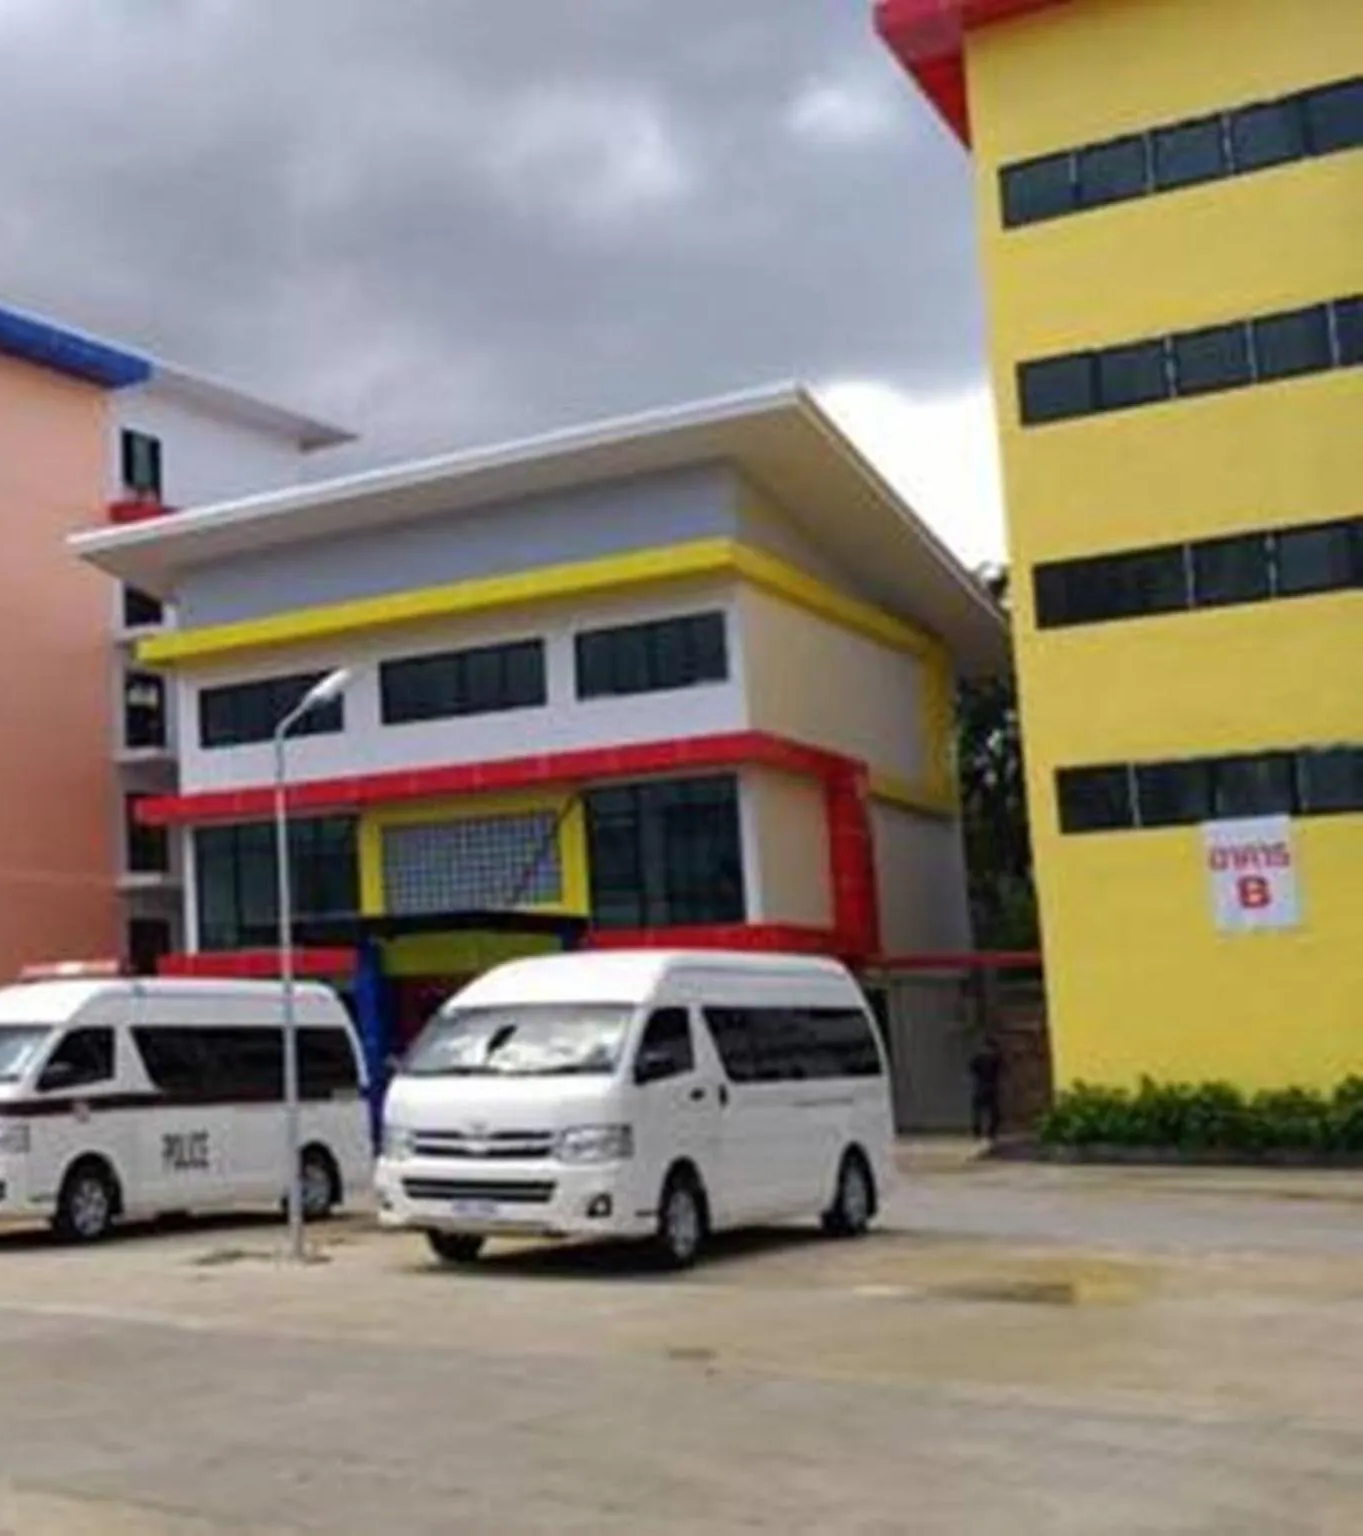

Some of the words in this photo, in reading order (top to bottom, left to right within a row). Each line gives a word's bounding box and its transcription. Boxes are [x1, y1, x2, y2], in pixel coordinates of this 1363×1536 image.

[1207, 842, 1291, 872] อาคาร
[1237, 875, 1271, 910] B
[161, 1129, 210, 1171] POLICE
